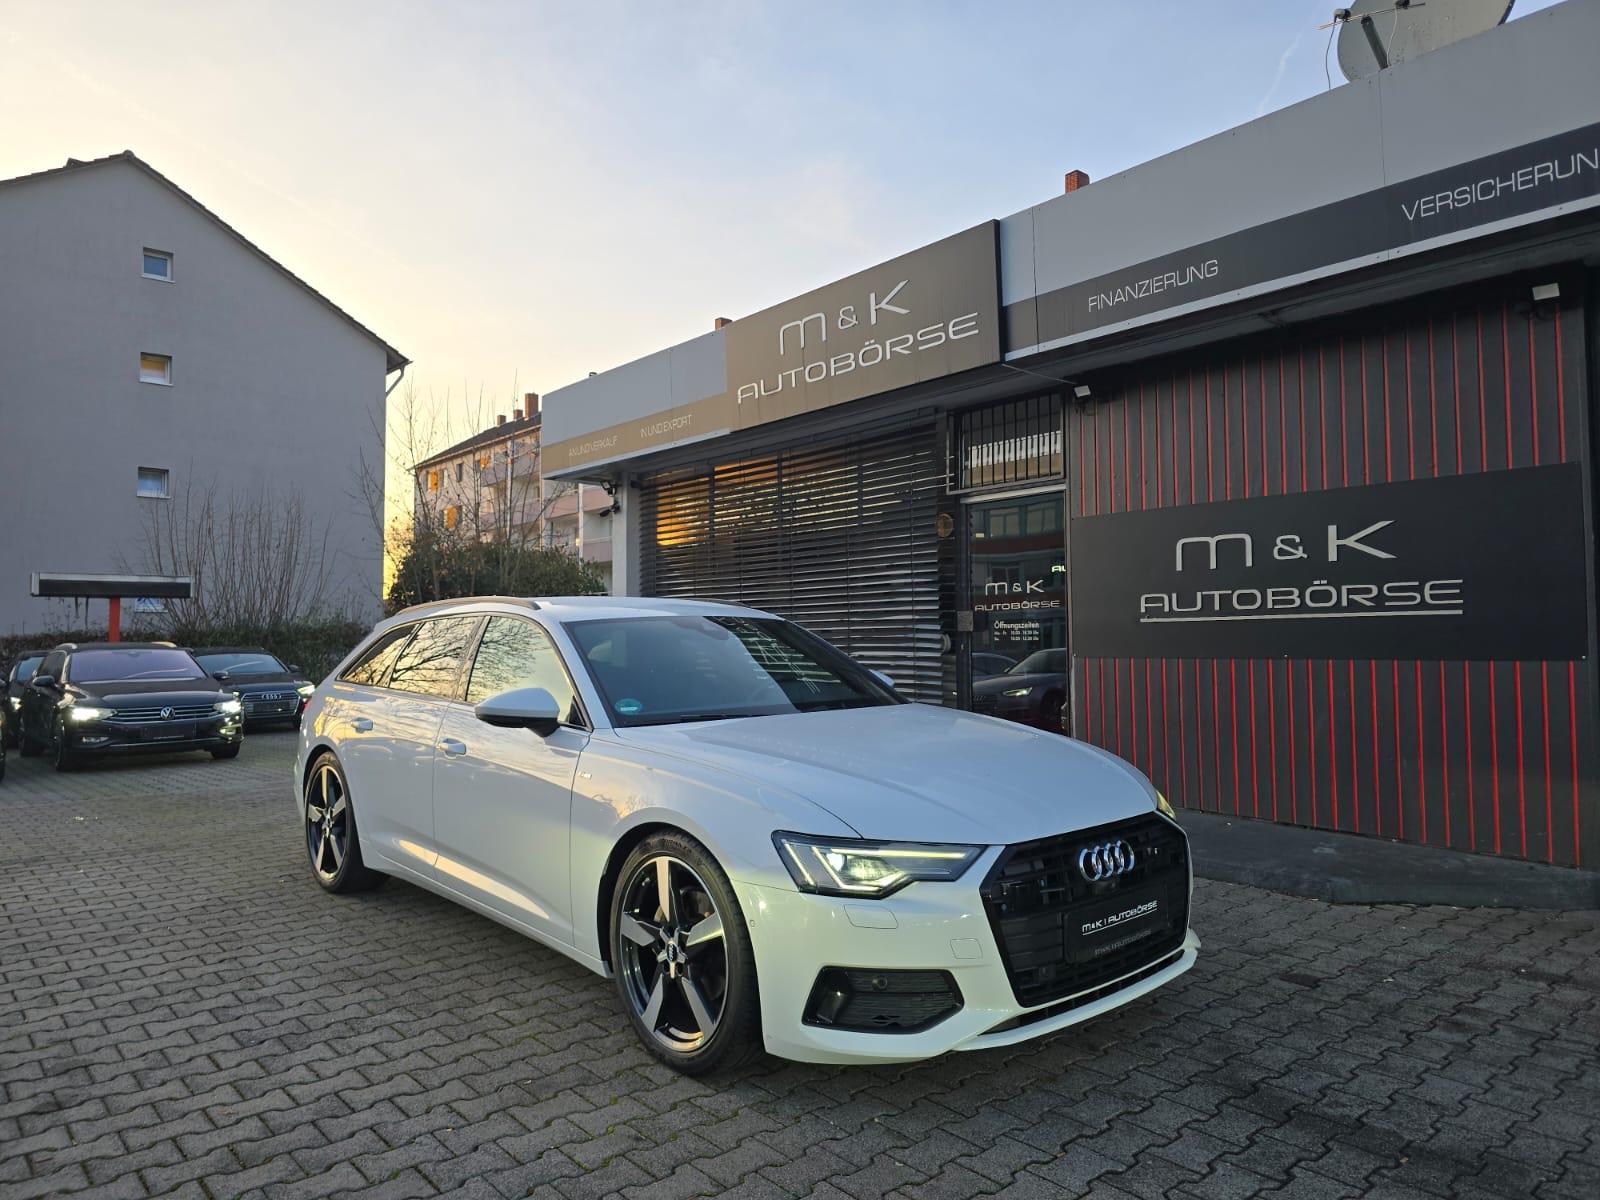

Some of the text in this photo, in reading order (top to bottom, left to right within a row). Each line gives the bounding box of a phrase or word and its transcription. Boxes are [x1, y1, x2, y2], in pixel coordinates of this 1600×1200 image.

[1401, 147, 1599, 221] VERSICHERUN
[837, 305, 859, 330] &
[868, 279, 911, 325] K
[1088, 259, 1219, 313] FINANZIERUNG
[737, 311, 980, 404] AUTOBÖRSE
[1273, 534, 1308, 561] &
[1327, 520, 1398, 562] K
[974, 600, 1061, 612] AUTOBÖRSE
[1012, 582, 1023, 593] &
[1026, 579, 1045, 594] K
[1140, 579, 1464, 613] AUTOBÖRSE
[1108, 900, 1158, 923] AUTOBÖRSE
